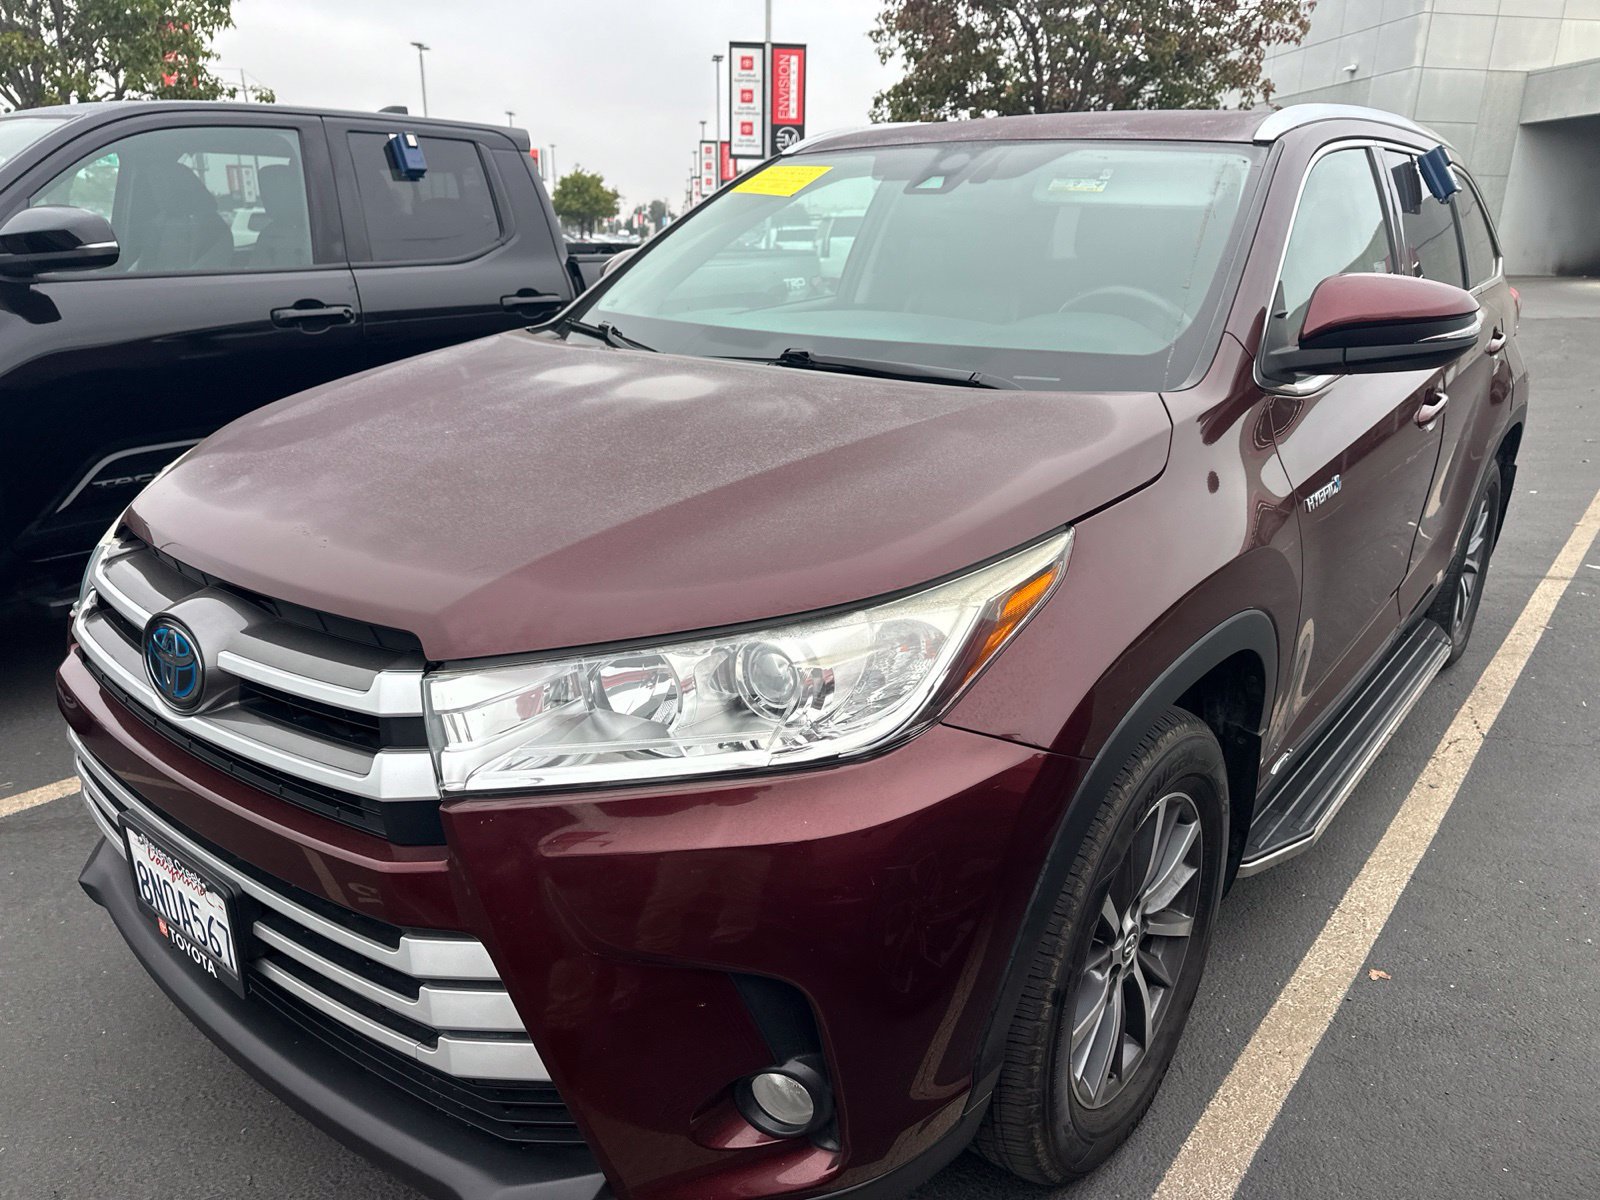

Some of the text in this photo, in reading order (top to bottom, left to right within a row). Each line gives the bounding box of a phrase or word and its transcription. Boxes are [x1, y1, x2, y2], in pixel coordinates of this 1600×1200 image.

[778, 54, 790, 119] ENVISION
[92, 472, 159, 487] TAC
[168, 926, 218, 979] TOYOTA
